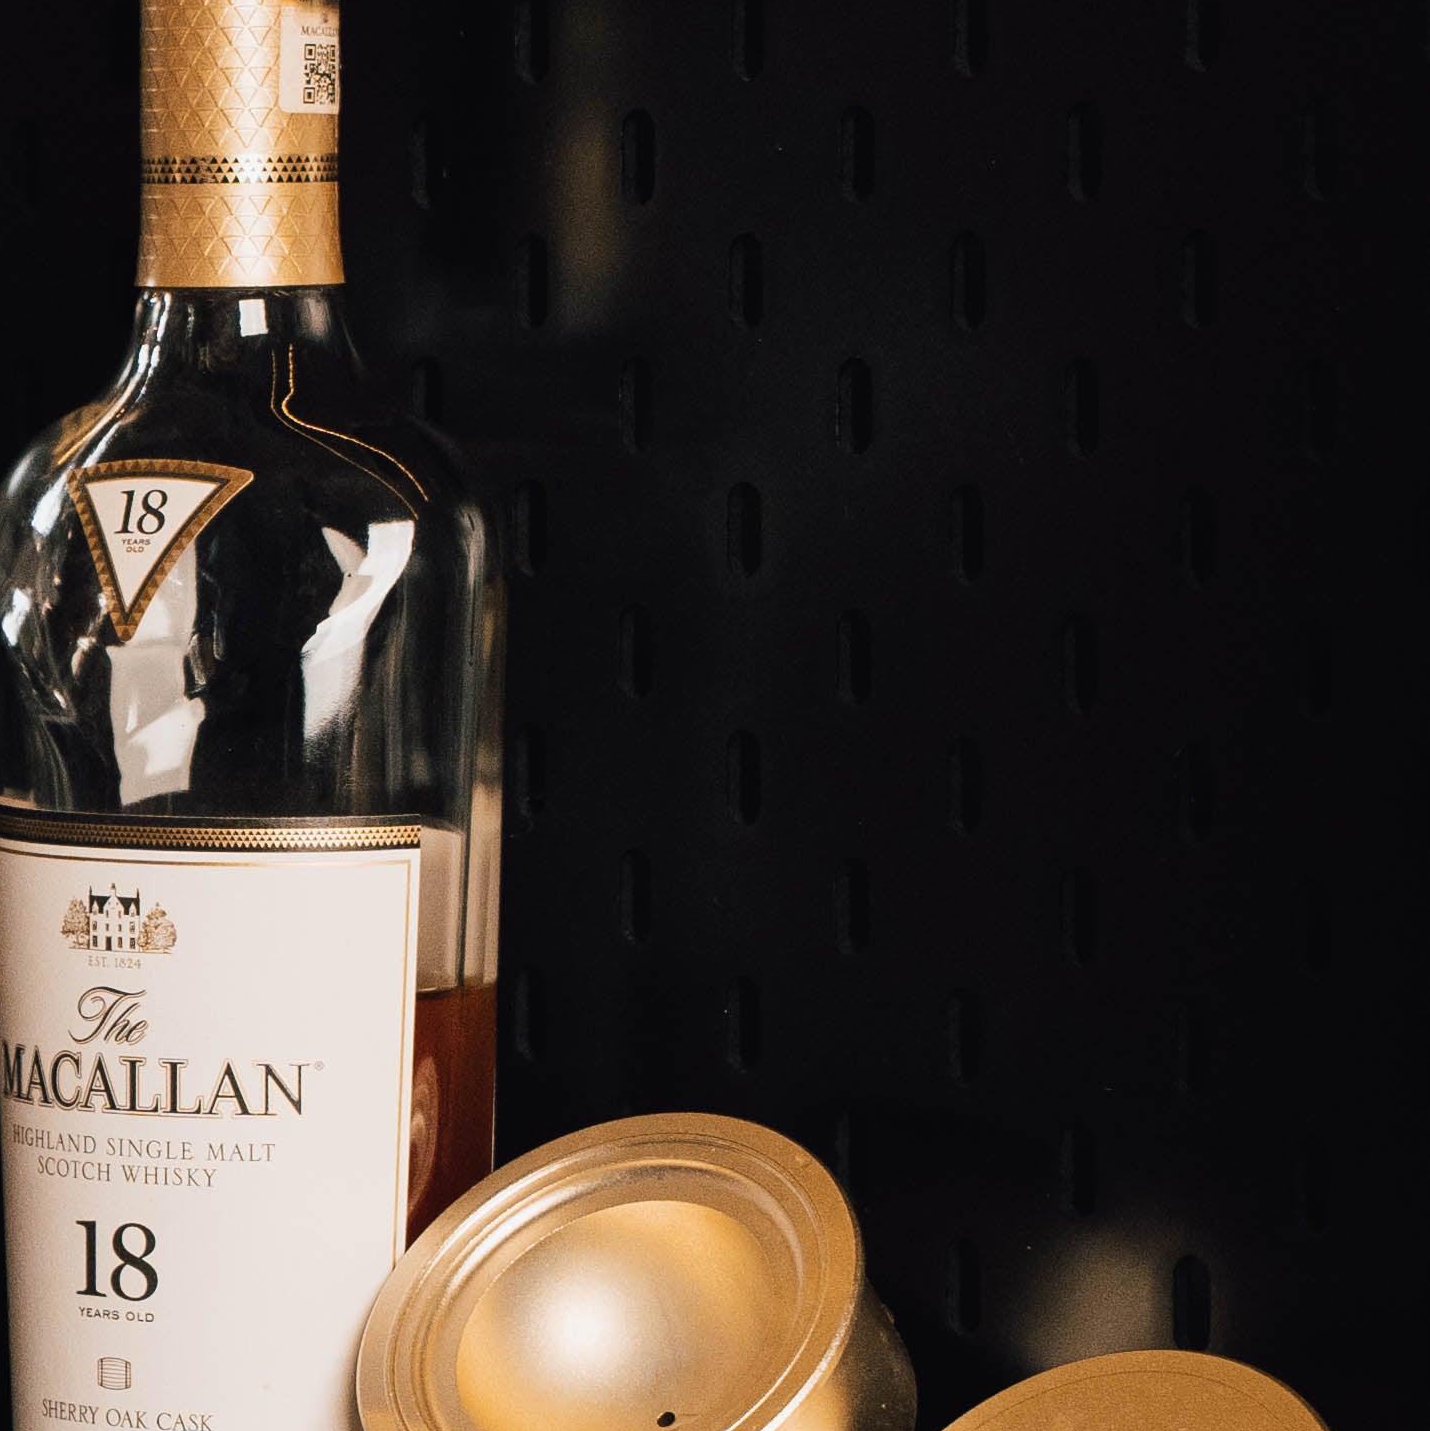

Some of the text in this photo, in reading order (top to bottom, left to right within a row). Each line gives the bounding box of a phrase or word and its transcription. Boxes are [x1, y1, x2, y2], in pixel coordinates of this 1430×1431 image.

[113, 489, 168, 535] 18
[122, 538, 151, 546] YEARS
[88, 955, 142, 970] EST. 1824
[68, 986, 149, 1046] The
[0, 1040, 311, 1119] MACALLAN
[13, 1124, 276, 1162] HIGHLAND SINGLE MALT
[37, 1155, 218, 1188] SCOTCH WHISKY
[75, 1220, 159, 1302] 18
[79, 1306, 155, 1323] YEARS OLD
[42, 1398, 99, 1425] SHERRY
[105, 1408, 149, 1430] OAK
